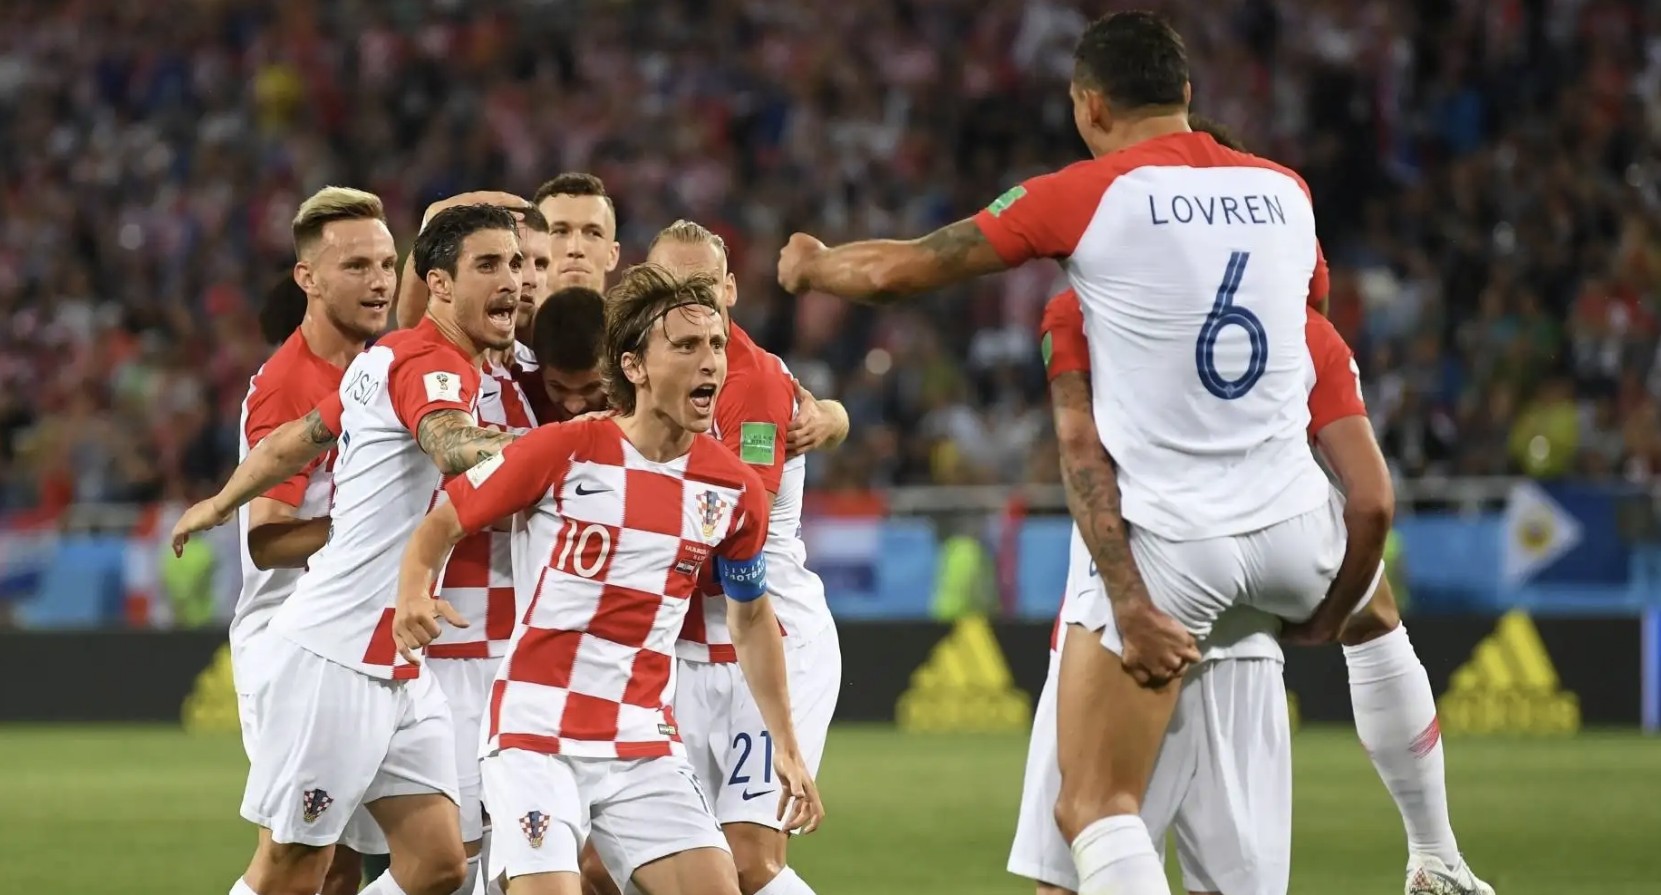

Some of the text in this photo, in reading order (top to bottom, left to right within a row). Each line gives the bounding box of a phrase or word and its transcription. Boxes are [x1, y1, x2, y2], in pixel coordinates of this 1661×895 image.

[1149, 195, 1286, 225] LOVREN
[1196, 251, 1268, 400] 6
[557, 519, 610, 578] 10
[728, 730, 772, 785] 21
